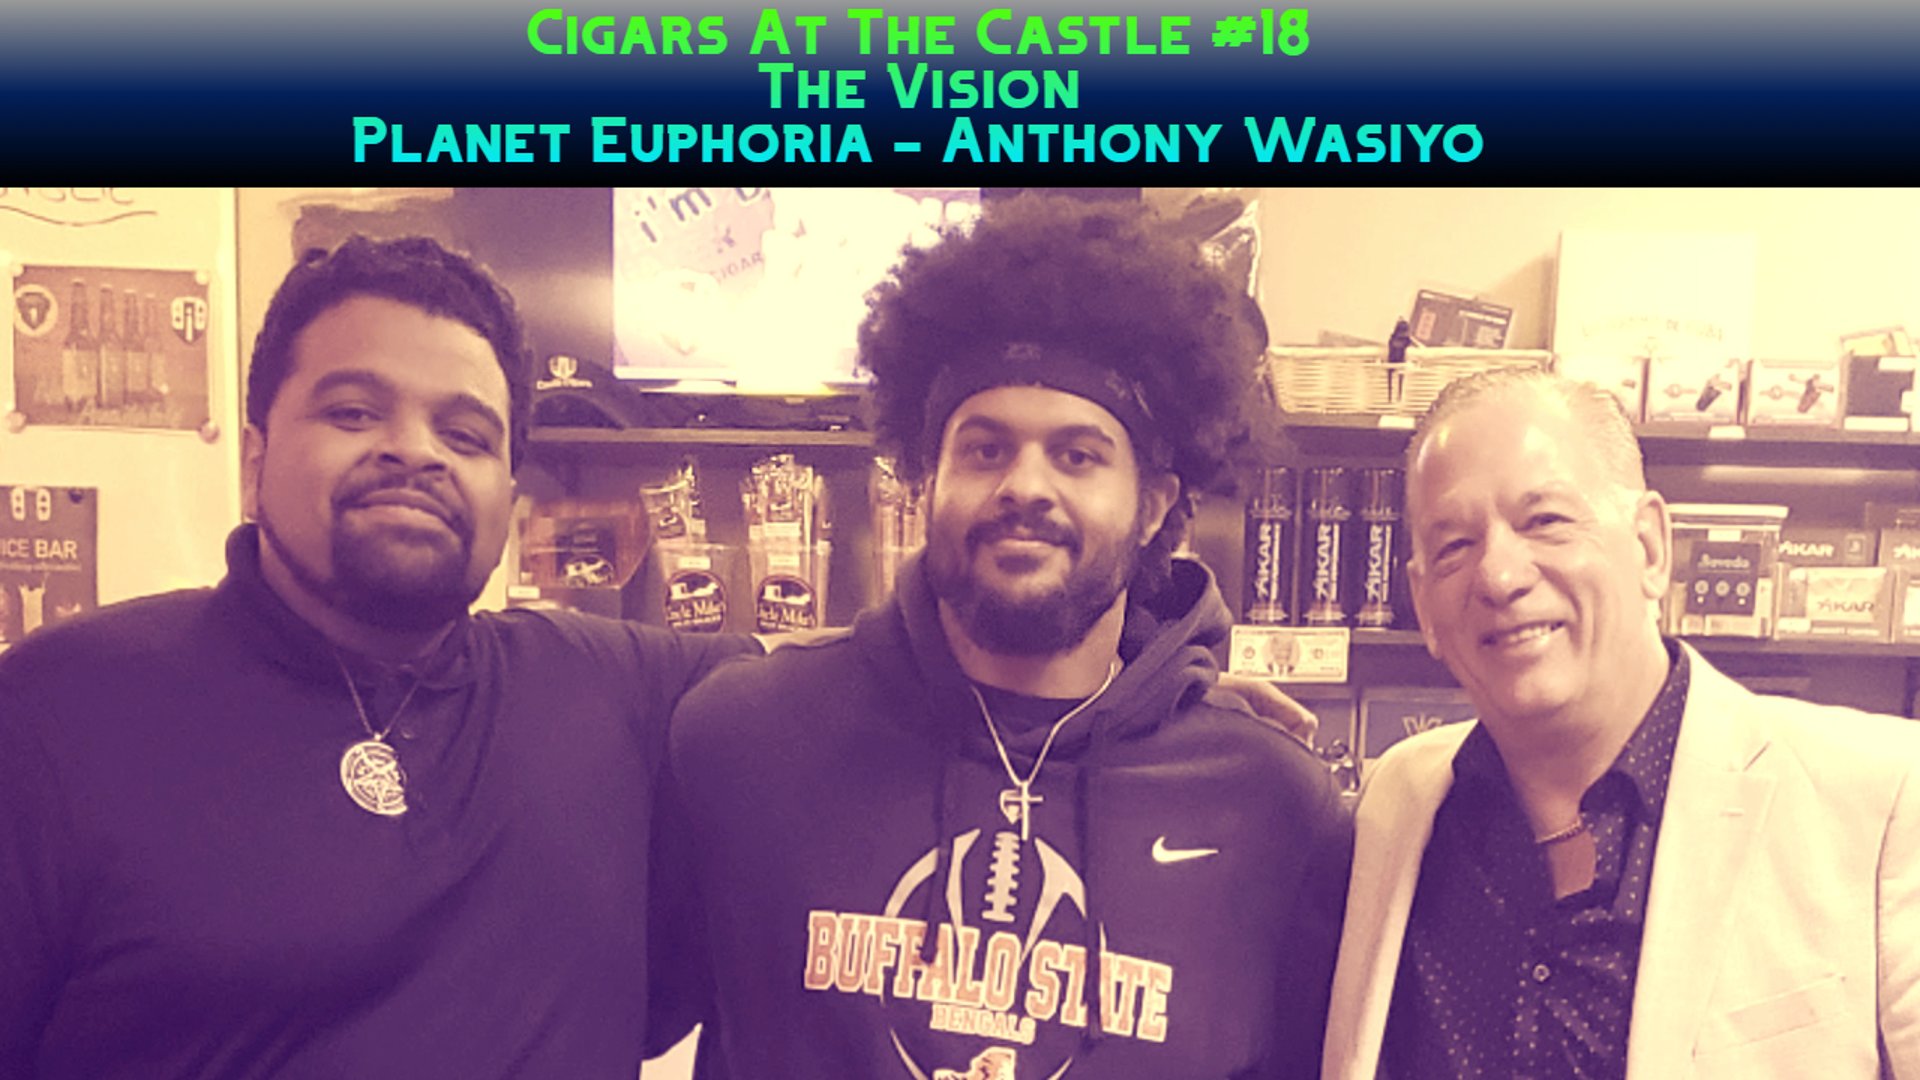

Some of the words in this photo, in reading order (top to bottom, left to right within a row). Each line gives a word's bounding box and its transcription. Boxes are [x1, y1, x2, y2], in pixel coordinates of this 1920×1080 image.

[35, 538, 78, 560] BAR
[803, 910, 1022, 1012] BUFFALO
[1024, 938, 1173, 1044] STTE
[929, 1000, 1037, 1046] BENGALS
